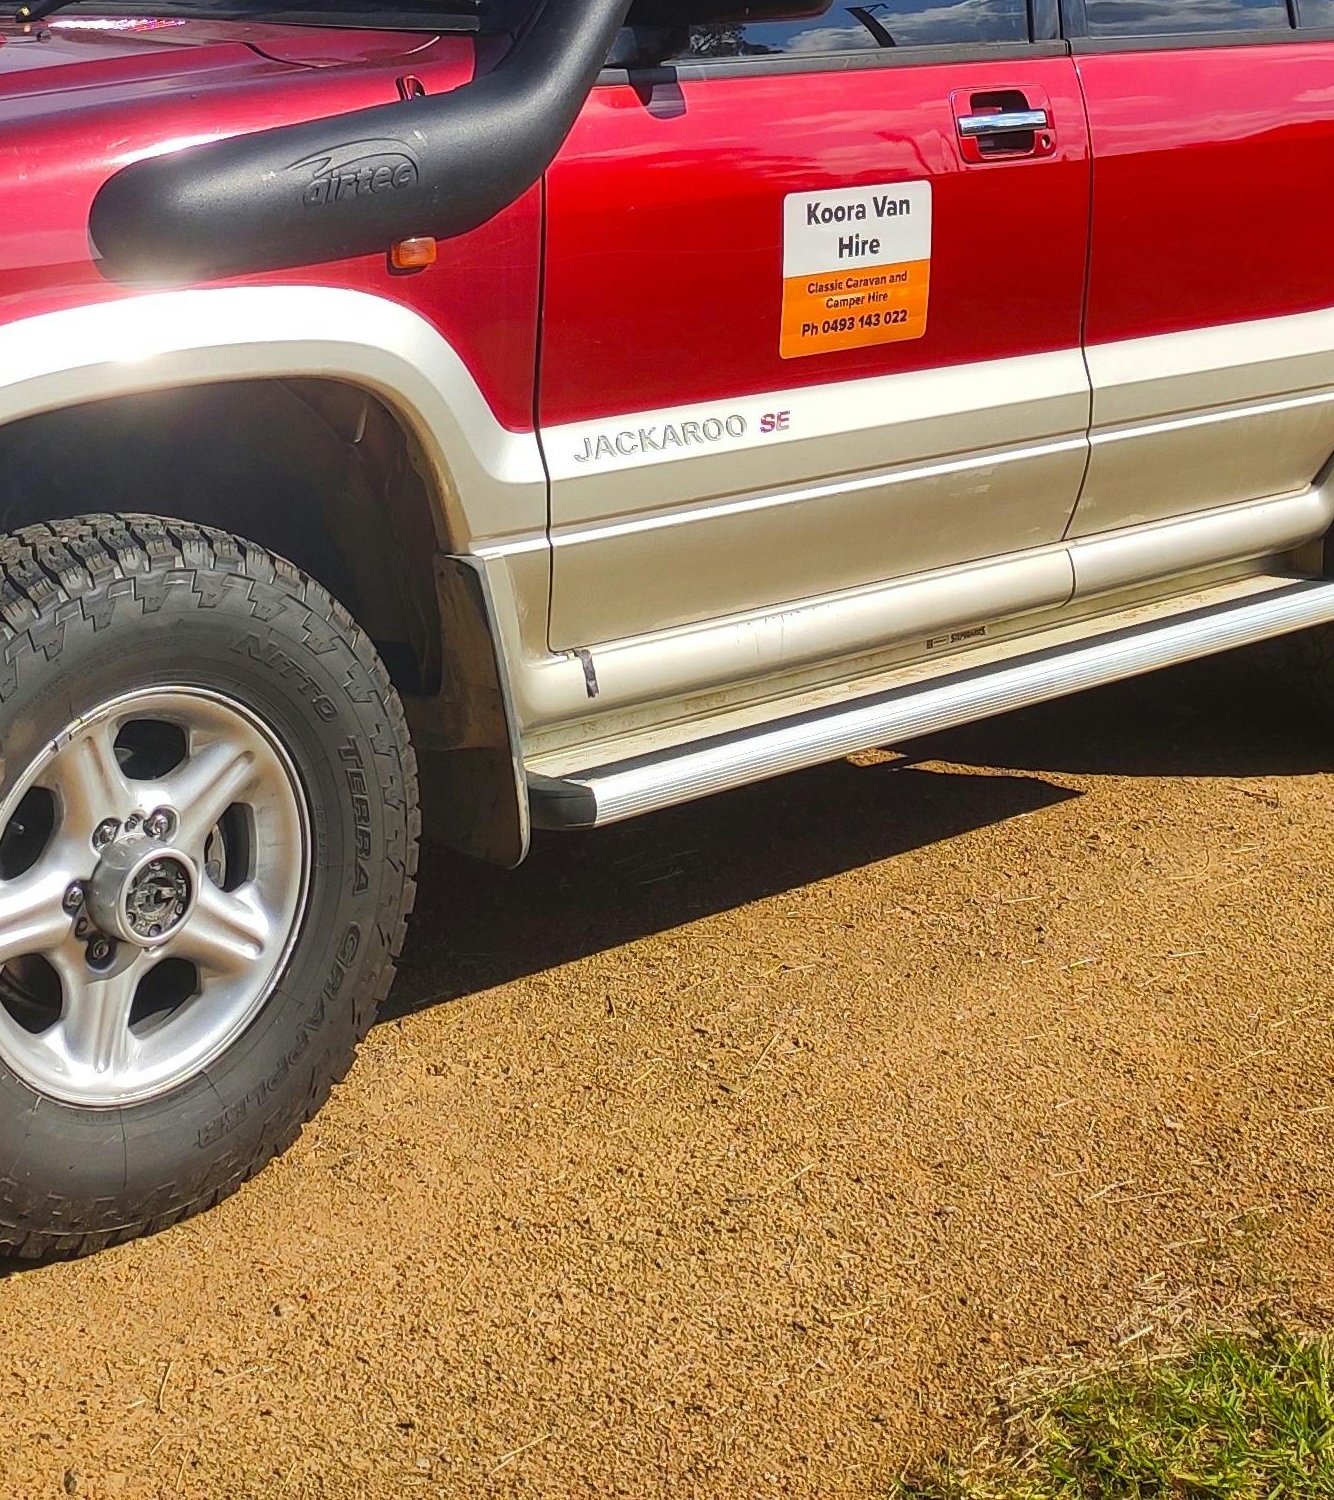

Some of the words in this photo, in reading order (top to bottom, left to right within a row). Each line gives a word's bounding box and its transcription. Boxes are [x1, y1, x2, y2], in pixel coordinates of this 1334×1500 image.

[806, 202, 866, 225] Koora
[873, 195, 911, 218] Van
[838, 233, 881, 258] Hire
[807, 279, 844, 294] Classic
[845, 276, 887, 289] Caravan
[889, 271, 907, 284] and
[826, 295, 866, 309] Camper
[868, 291, 888, 304] Hire
[801, 323, 818, 337] Ph
[822, 315, 854, 334] 0493
[858, 312, 880, 328] 143
[883, 309, 907, 324] 022
[574, 414, 748, 463] JACKAROO
[760, 410, 791, 433] SE
[230, 631, 339, 722] NITTO
[337, 735, 371, 896] TERRA
